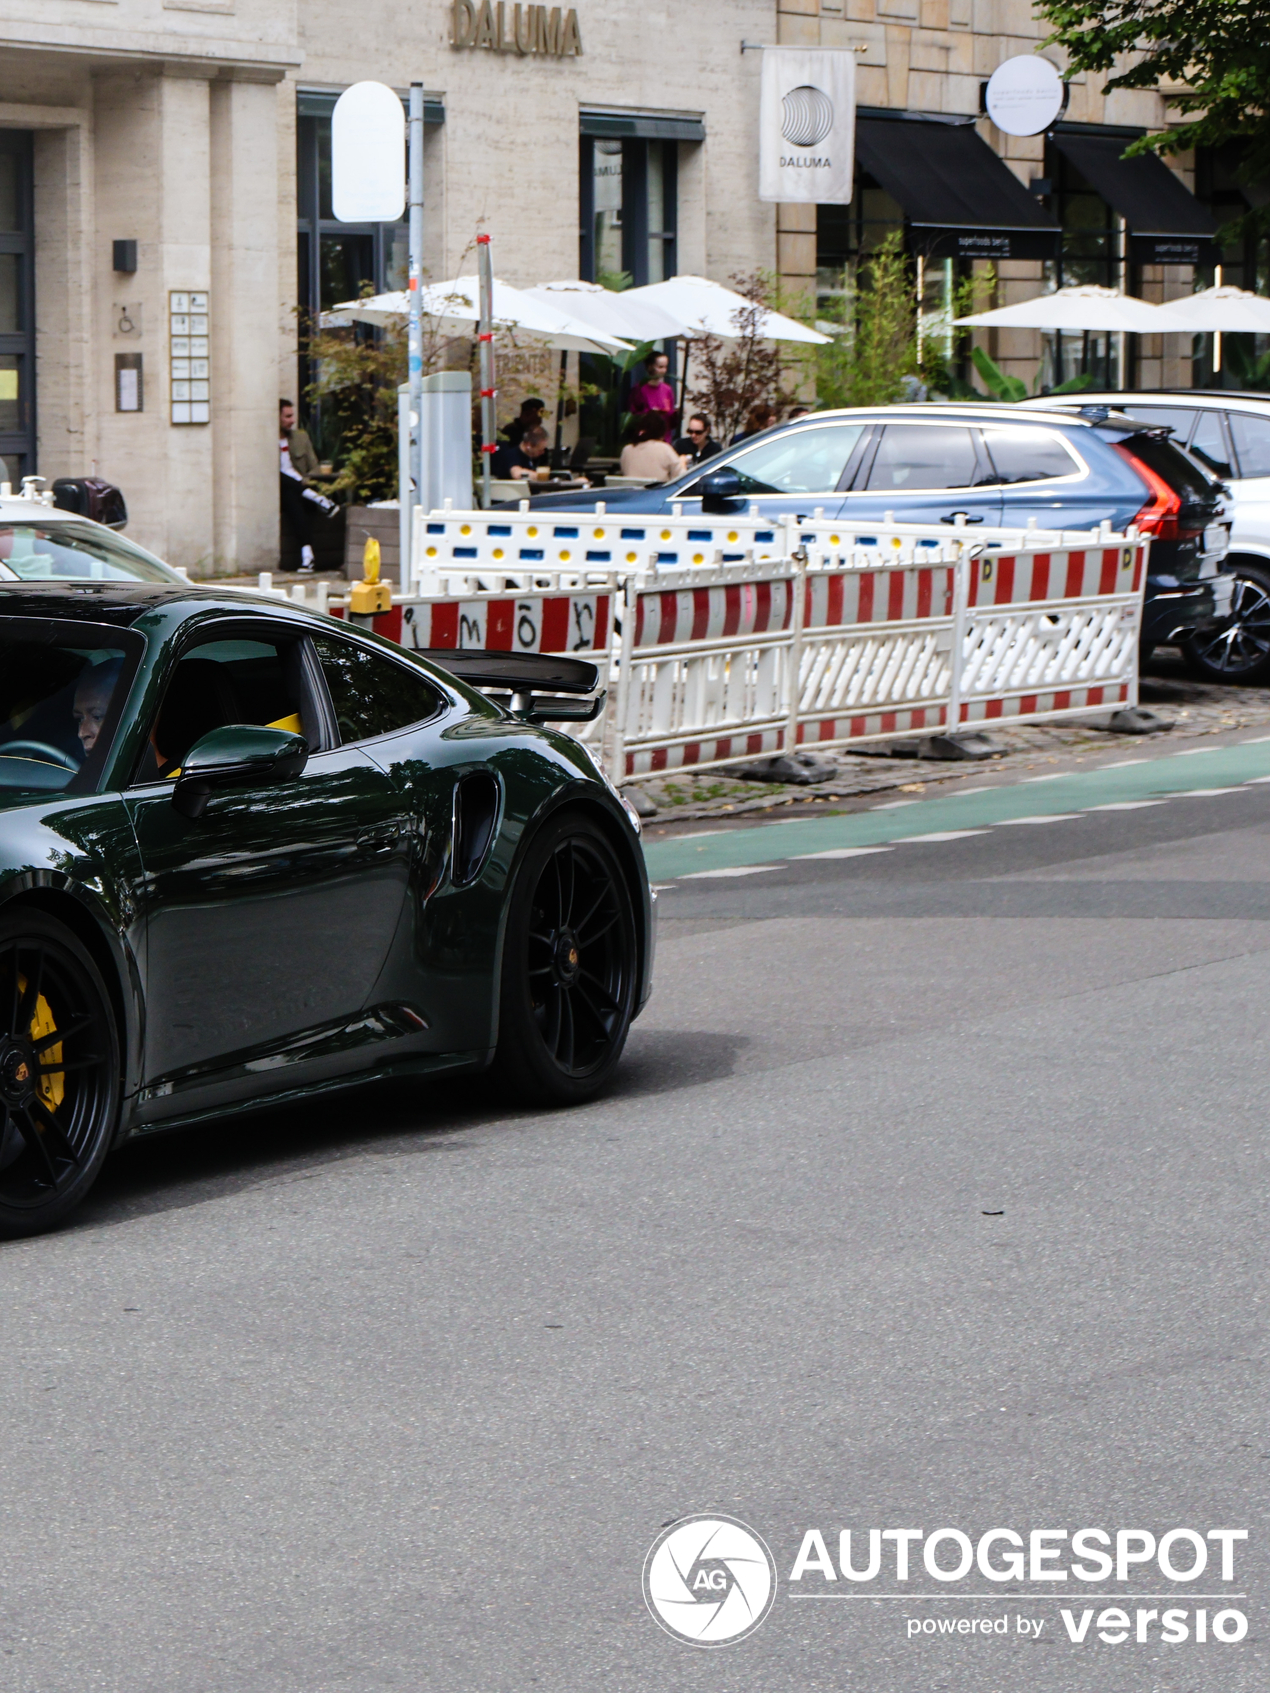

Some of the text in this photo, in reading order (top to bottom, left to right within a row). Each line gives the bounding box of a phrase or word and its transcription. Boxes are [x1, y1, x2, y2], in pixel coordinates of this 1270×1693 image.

[449, 0, 583, 56] DALUMA
[779, 156, 832, 169] DALUMA
[1123, 548, 1132, 569] D
[983, 559, 993, 581] D
